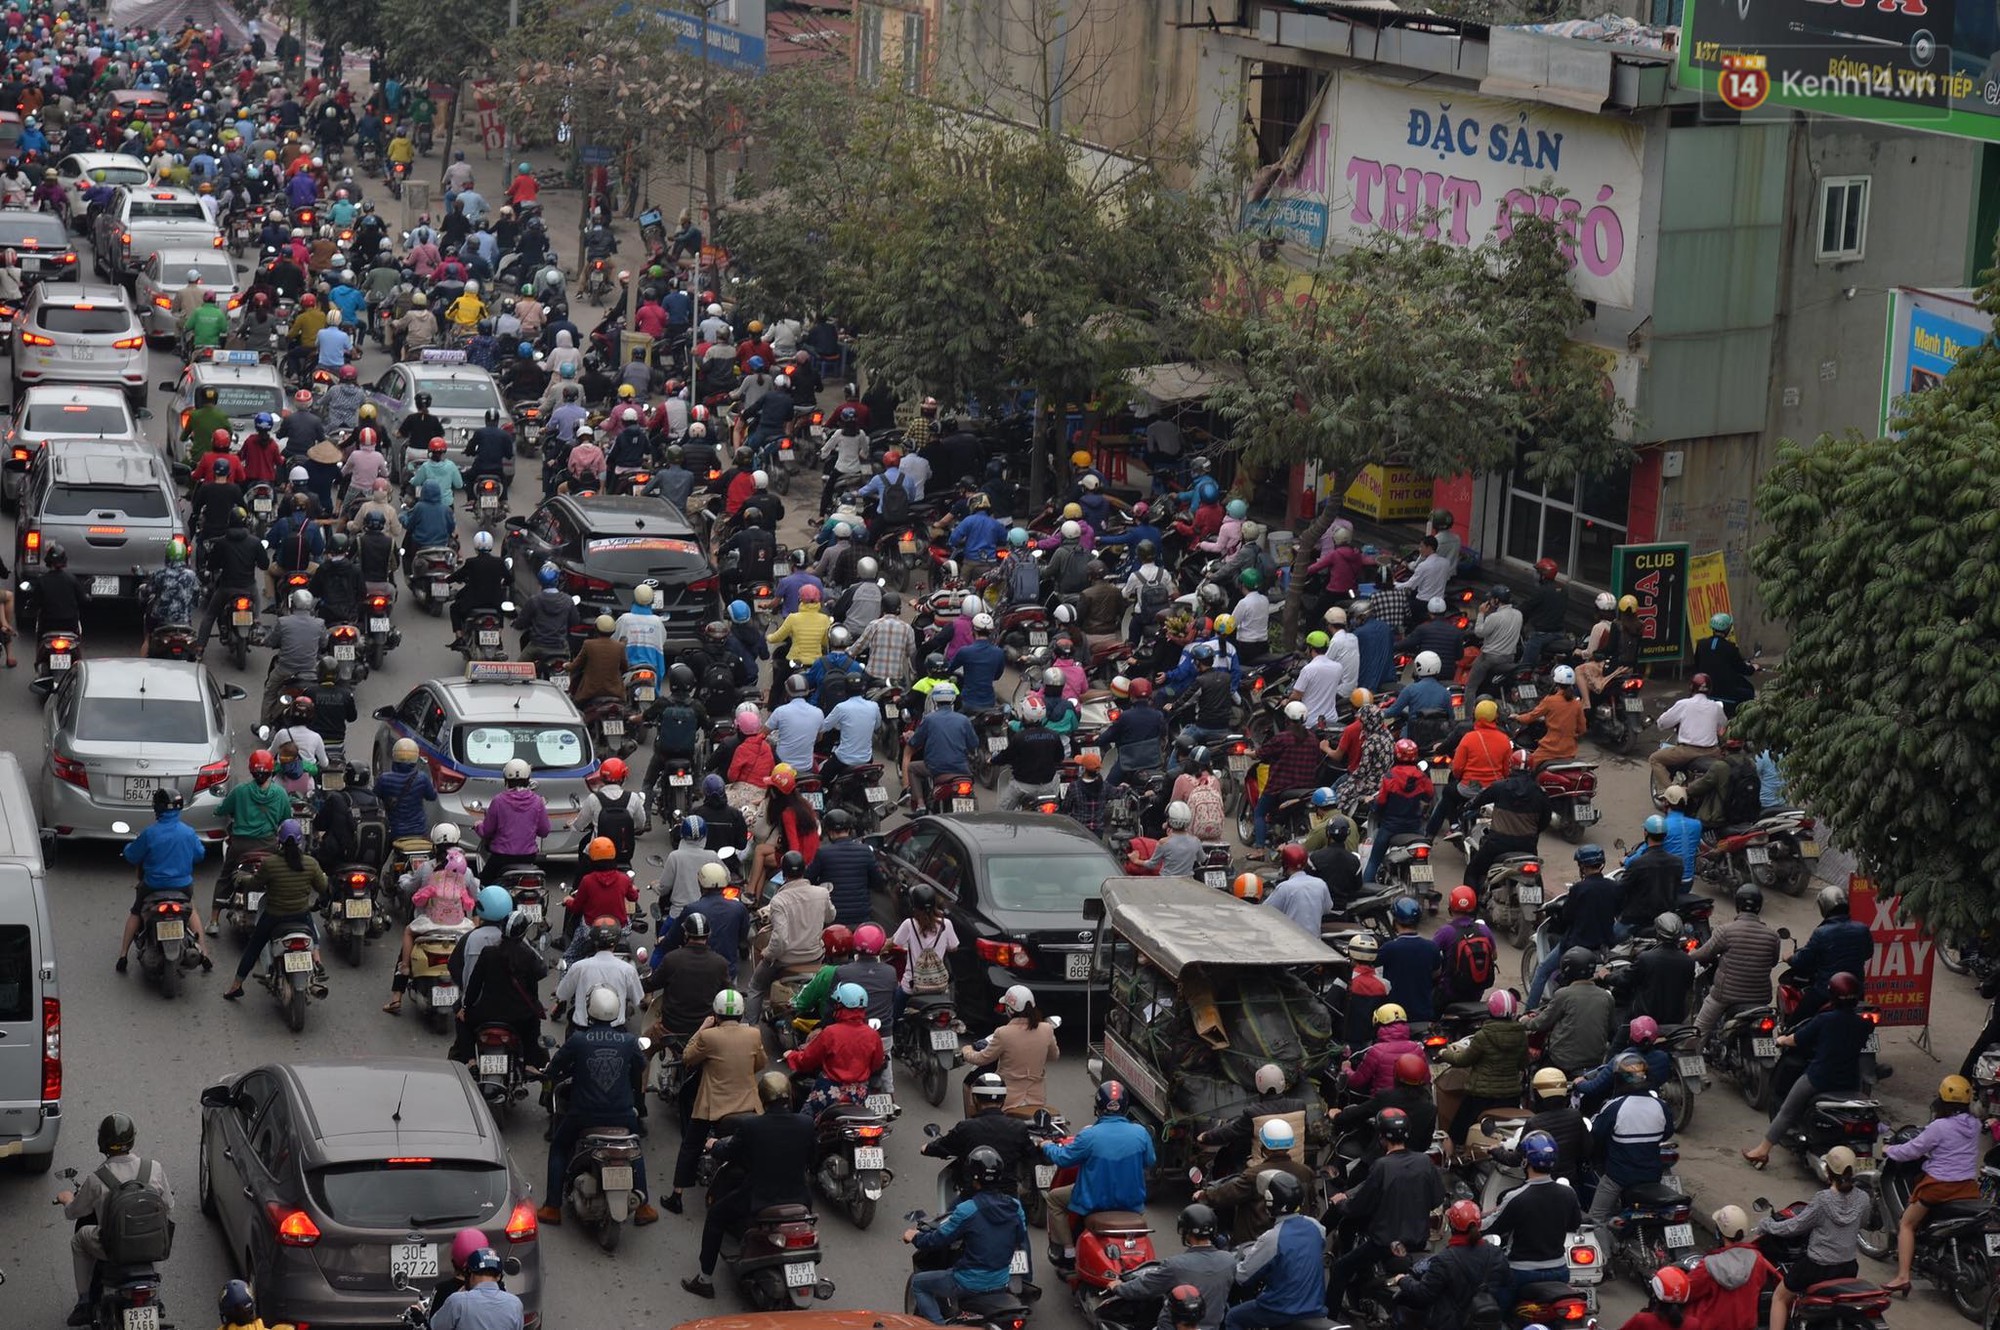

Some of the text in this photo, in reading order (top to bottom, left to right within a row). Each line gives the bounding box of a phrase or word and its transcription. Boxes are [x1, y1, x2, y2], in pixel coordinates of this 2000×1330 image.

[1940, 69, 1974, 99] TIẾP
[1407, 102, 1564, 173] ĐẶC SẢN
[1635, 553, 1675, 569] CLUB
[133, 778, 152, 789] 30A
[1907, 991, 1926, 1004] XE
[586, 1030, 626, 1043] GUCCI
[401, 1243, 427, 1260] 30E
[393, 1261, 438, 1277] 837.22
[788, 1263, 812, 1275] 29-P1
[129, 1309, 154, 1321] 28-S7
